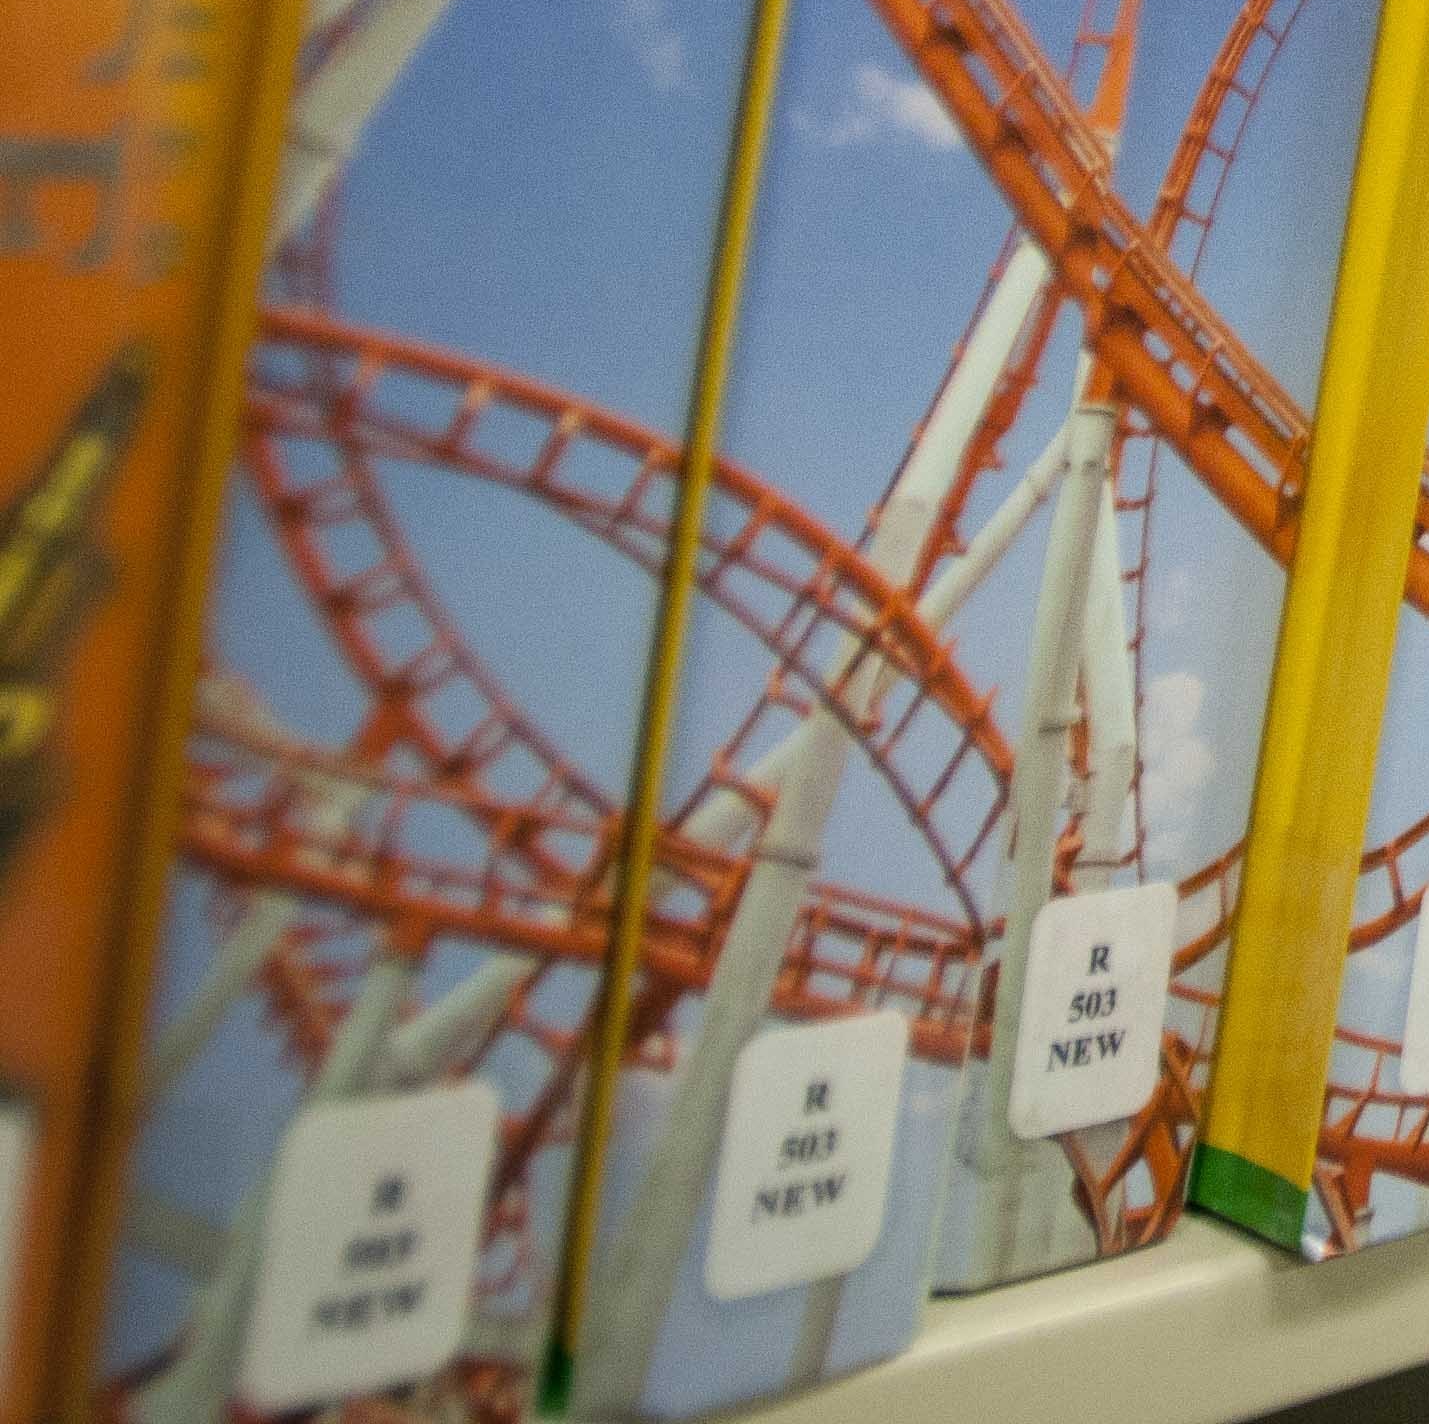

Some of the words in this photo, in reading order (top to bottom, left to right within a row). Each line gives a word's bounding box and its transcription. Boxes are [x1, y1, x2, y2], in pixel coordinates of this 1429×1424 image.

[1087, 942, 1114, 977] R
[1067, 988, 1120, 1023] 503
[1044, 1028, 1128, 1074] NEW
[803, 1077, 830, 1114] R
[748, 1176, 850, 1224] NEW
